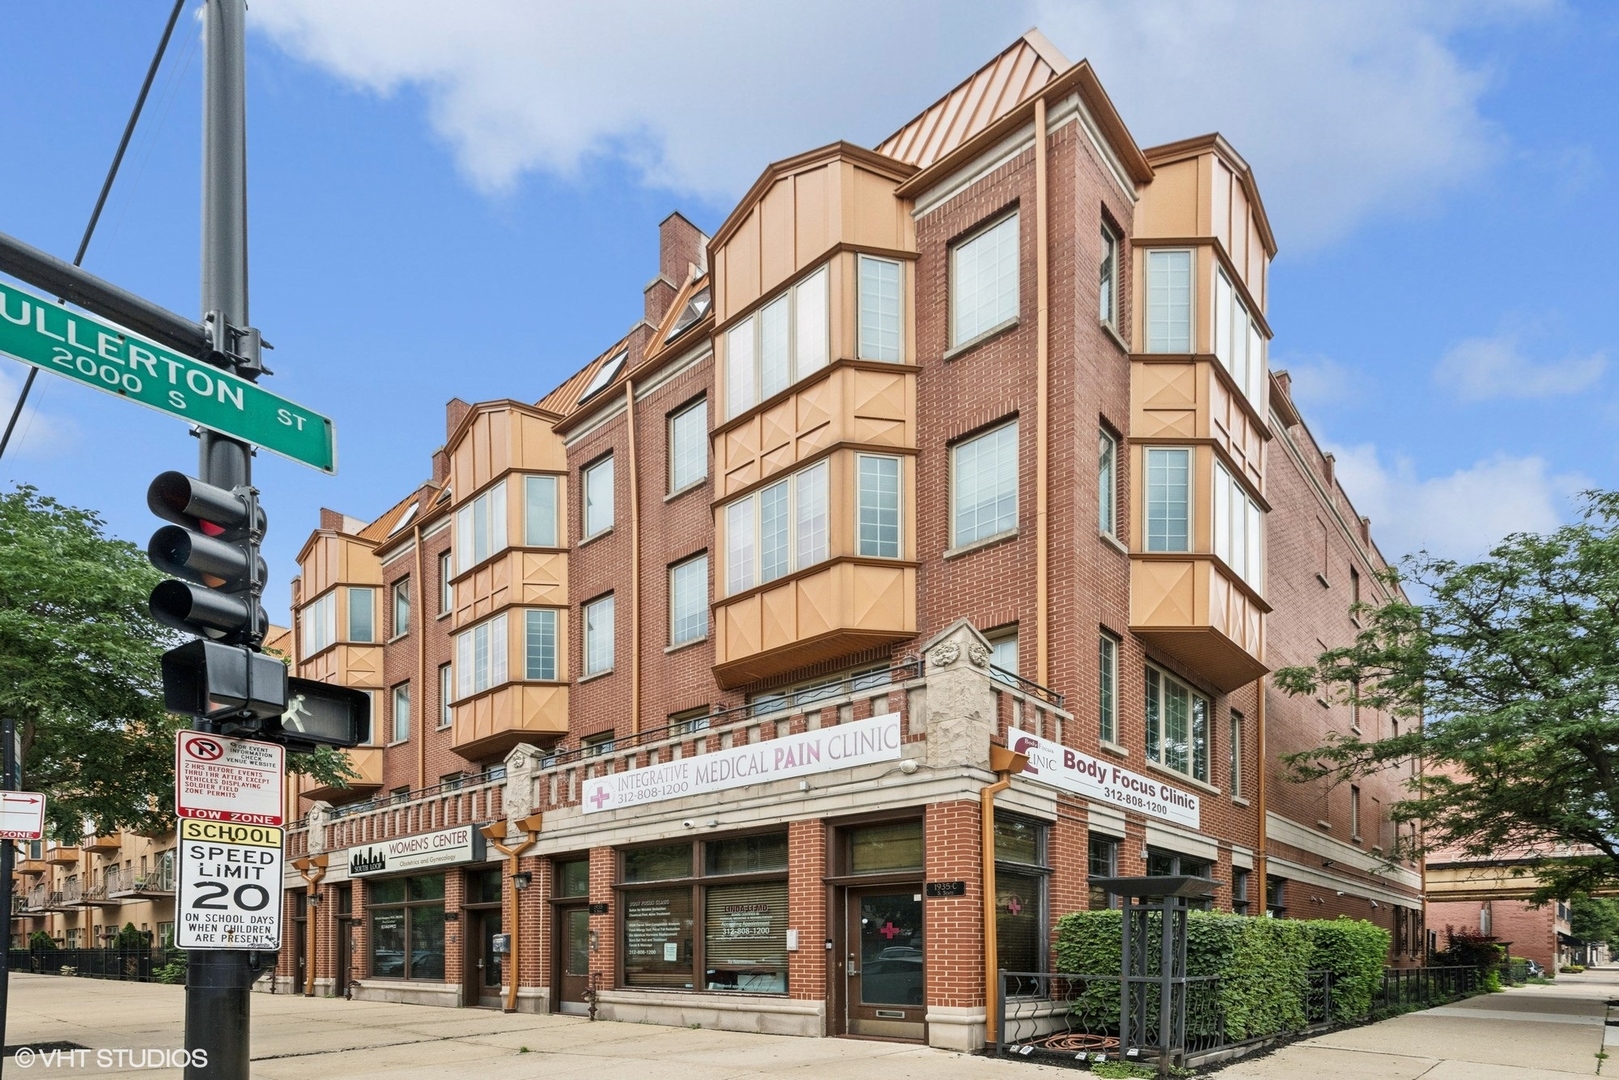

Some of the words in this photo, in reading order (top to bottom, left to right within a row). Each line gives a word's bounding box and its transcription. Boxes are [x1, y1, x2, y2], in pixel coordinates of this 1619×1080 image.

[52, 346, 142, 393] 2000
[168, 390, 187, 410] S
[277, 408, 307, 431] ST
[230, 748, 273, 758] INFORMATION
[618, 763, 688, 792] INTEGRATIVE
[695, 754, 768, 786] MEDICAL
[774, 739, 821, 770] PAIN
[828, 723, 899, 760] CLINIC
[208, 766, 234, 774] BEFORE
[185, 776, 218, 784] VEHICLES
[222, 780, 262, 790] DISPLAYING
[185, 782, 216, 790] SOLDIER
[246, 776, 270, 784] EXCEPT
[1063, 749, 1107, 785] Body
[1112, 767, 1156, 797] Focus
[1160, 785, 1196, 811] Clinic
[207, 790, 236, 798] PERMITS
[618, 781, 689, 804] 312-808-1200
[1104, 787, 1168, 815] 312-808-1200
[185, 808, 222, 820] TOW
[230, 812, 275, 824] ZONE
[188, 823, 277, 844] SCHOOL
[389, 837, 428, 855] WOMEN'S
[433, 830, 468, 848] CENTER
[190, 846, 274, 865] SPEED
[199, 862, 265, 880] LIMIT
[192, 881, 270, 912] 20
[185, 912, 200, 922] ON
[205, 914, 244, 924] SCHOOL
[250, 916, 274, 924] DAYS
[188, 924, 218, 932] WHEN
[224, 924, 271, 934] CHILDREN
[194, 934, 216, 942] ARE
[221, 934, 264, 943] PRESENT
